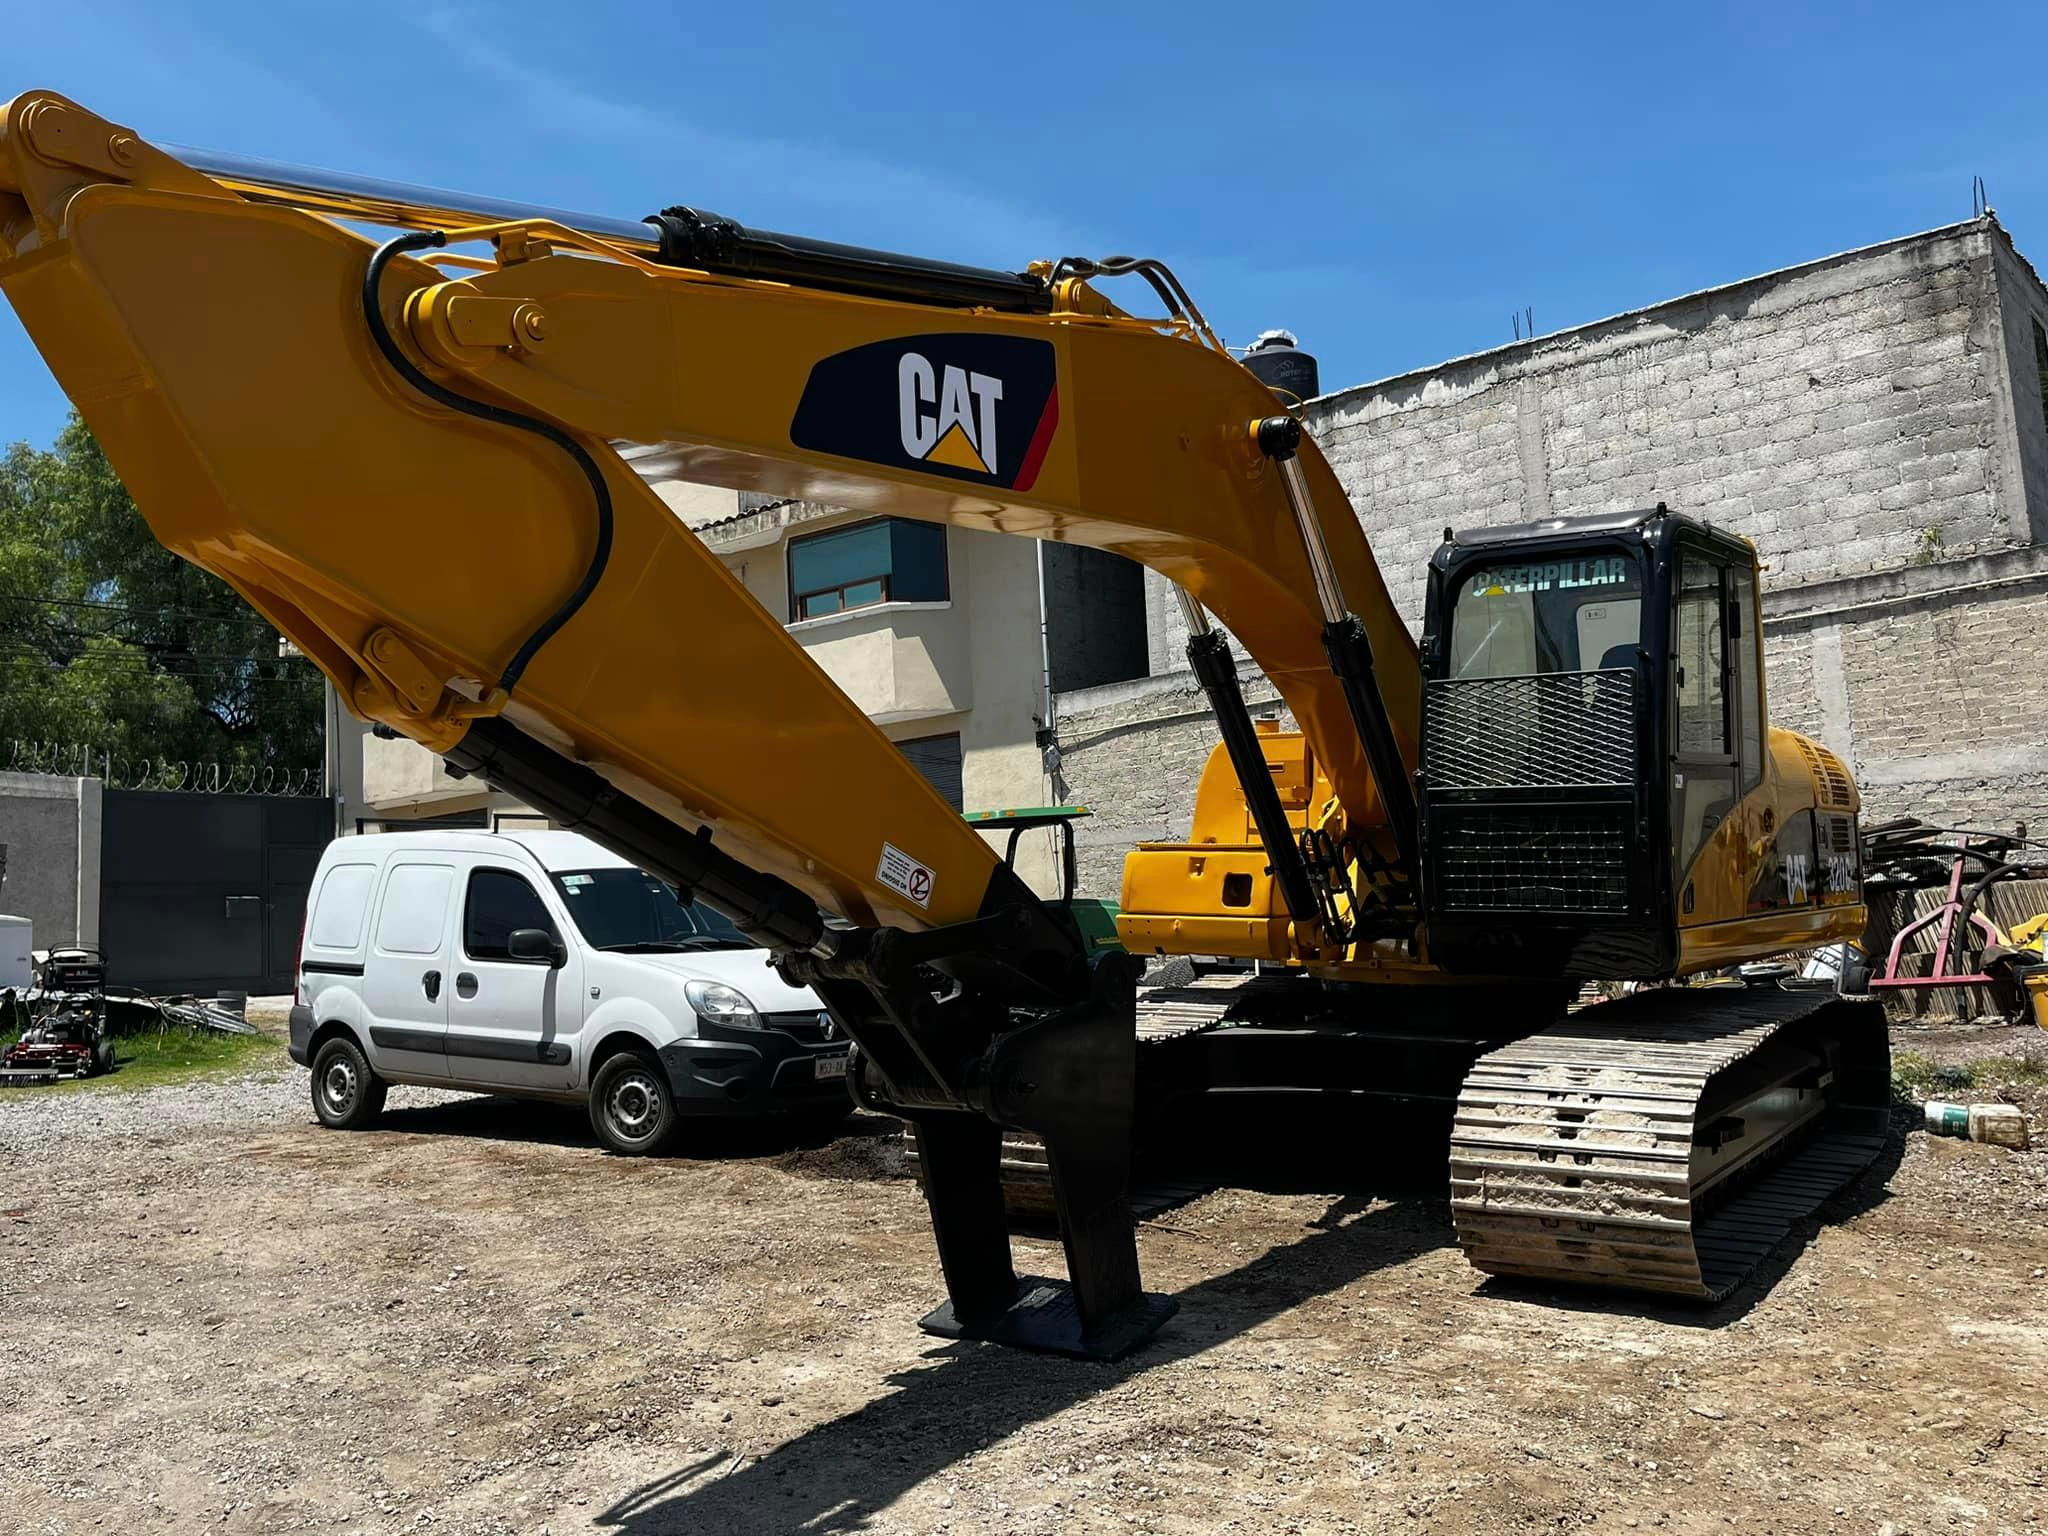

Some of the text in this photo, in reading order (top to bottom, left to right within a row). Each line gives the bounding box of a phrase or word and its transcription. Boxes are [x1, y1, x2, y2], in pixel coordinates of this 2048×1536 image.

[899, 352, 1002, 474] CAT
[1473, 558, 1625, 597] CATERPILLAR
[1786, 854, 1808, 904] CAT
